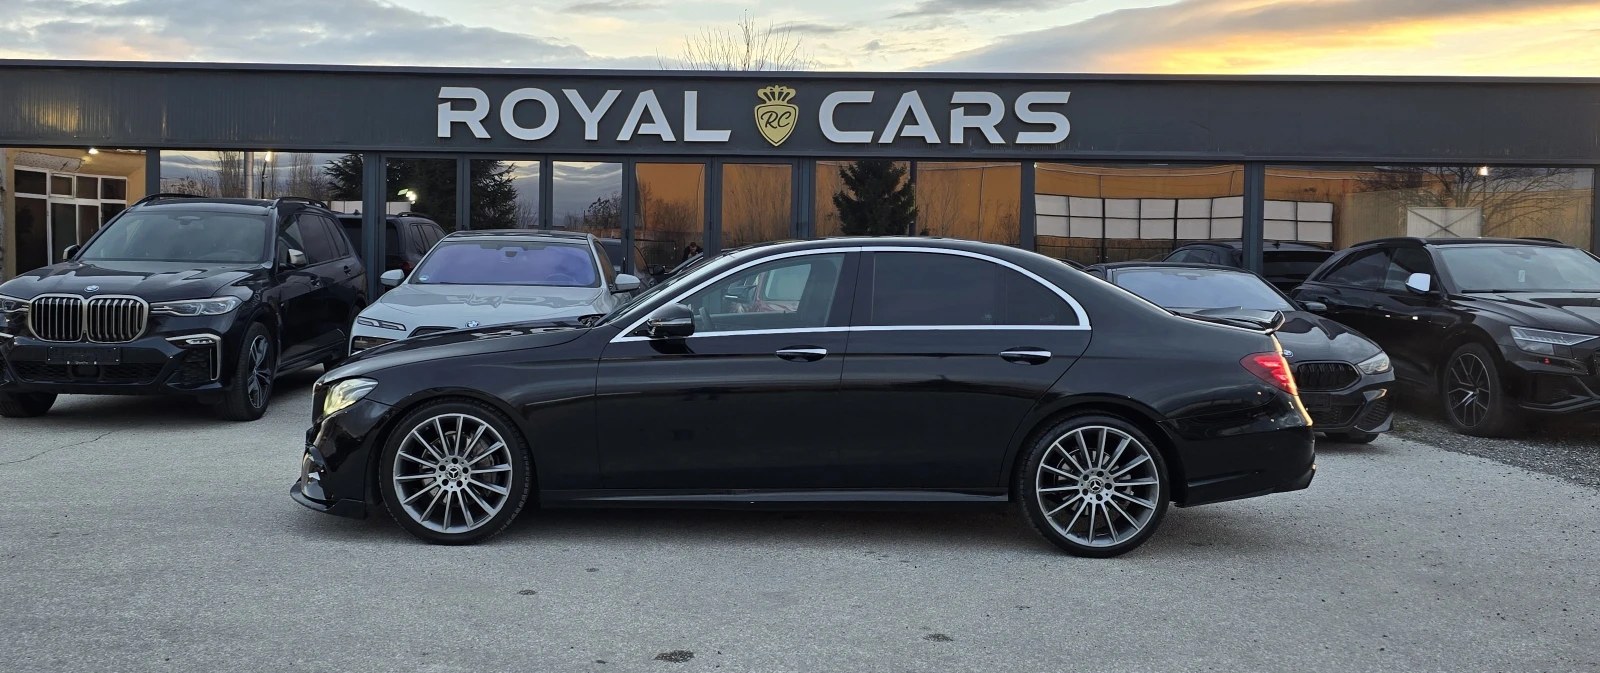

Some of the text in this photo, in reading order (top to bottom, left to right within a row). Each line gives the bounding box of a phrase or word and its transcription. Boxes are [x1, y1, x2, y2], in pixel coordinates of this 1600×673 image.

[436, 86, 1072, 145] ROYAL CARS
[760, 110, 792, 129] RC
